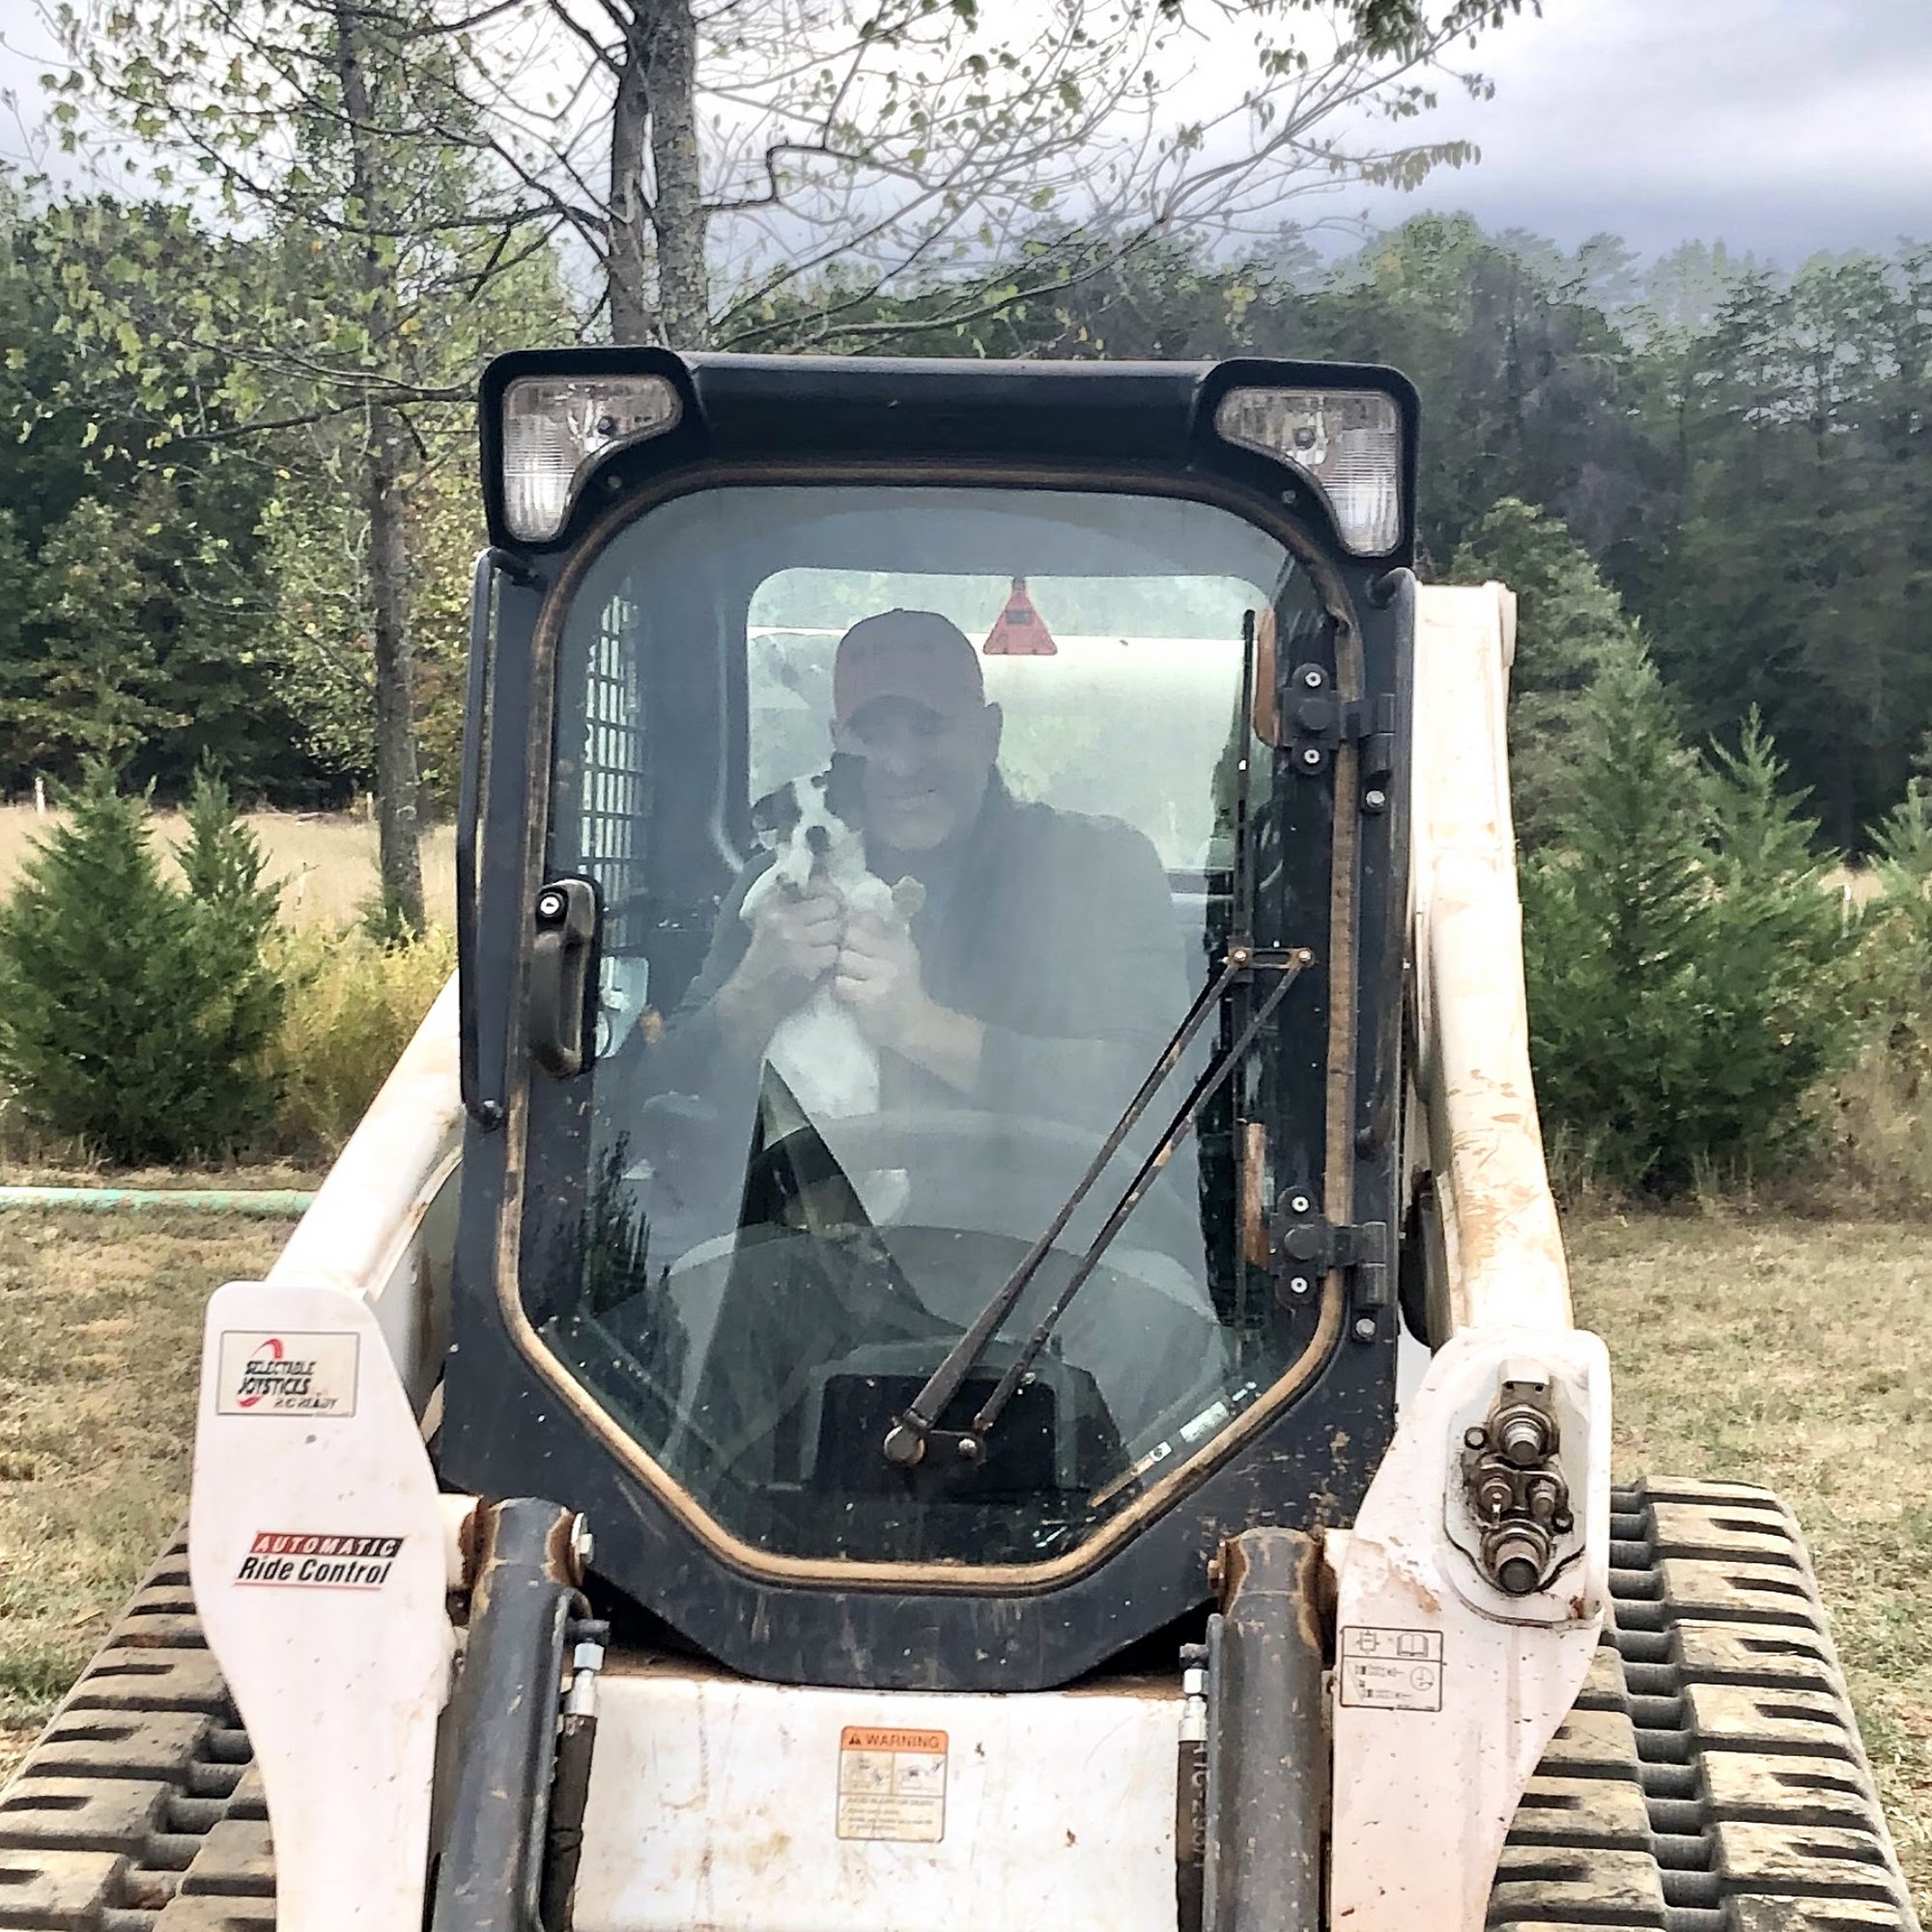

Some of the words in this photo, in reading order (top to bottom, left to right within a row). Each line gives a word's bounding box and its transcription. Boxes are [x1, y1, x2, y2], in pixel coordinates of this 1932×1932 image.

[254, 1535, 397, 1556] AUTOMATIC
[237, 1555, 295, 1580] Ride
[298, 1558, 394, 1584] Control
[866, 1732, 940, 1749] WARNING
